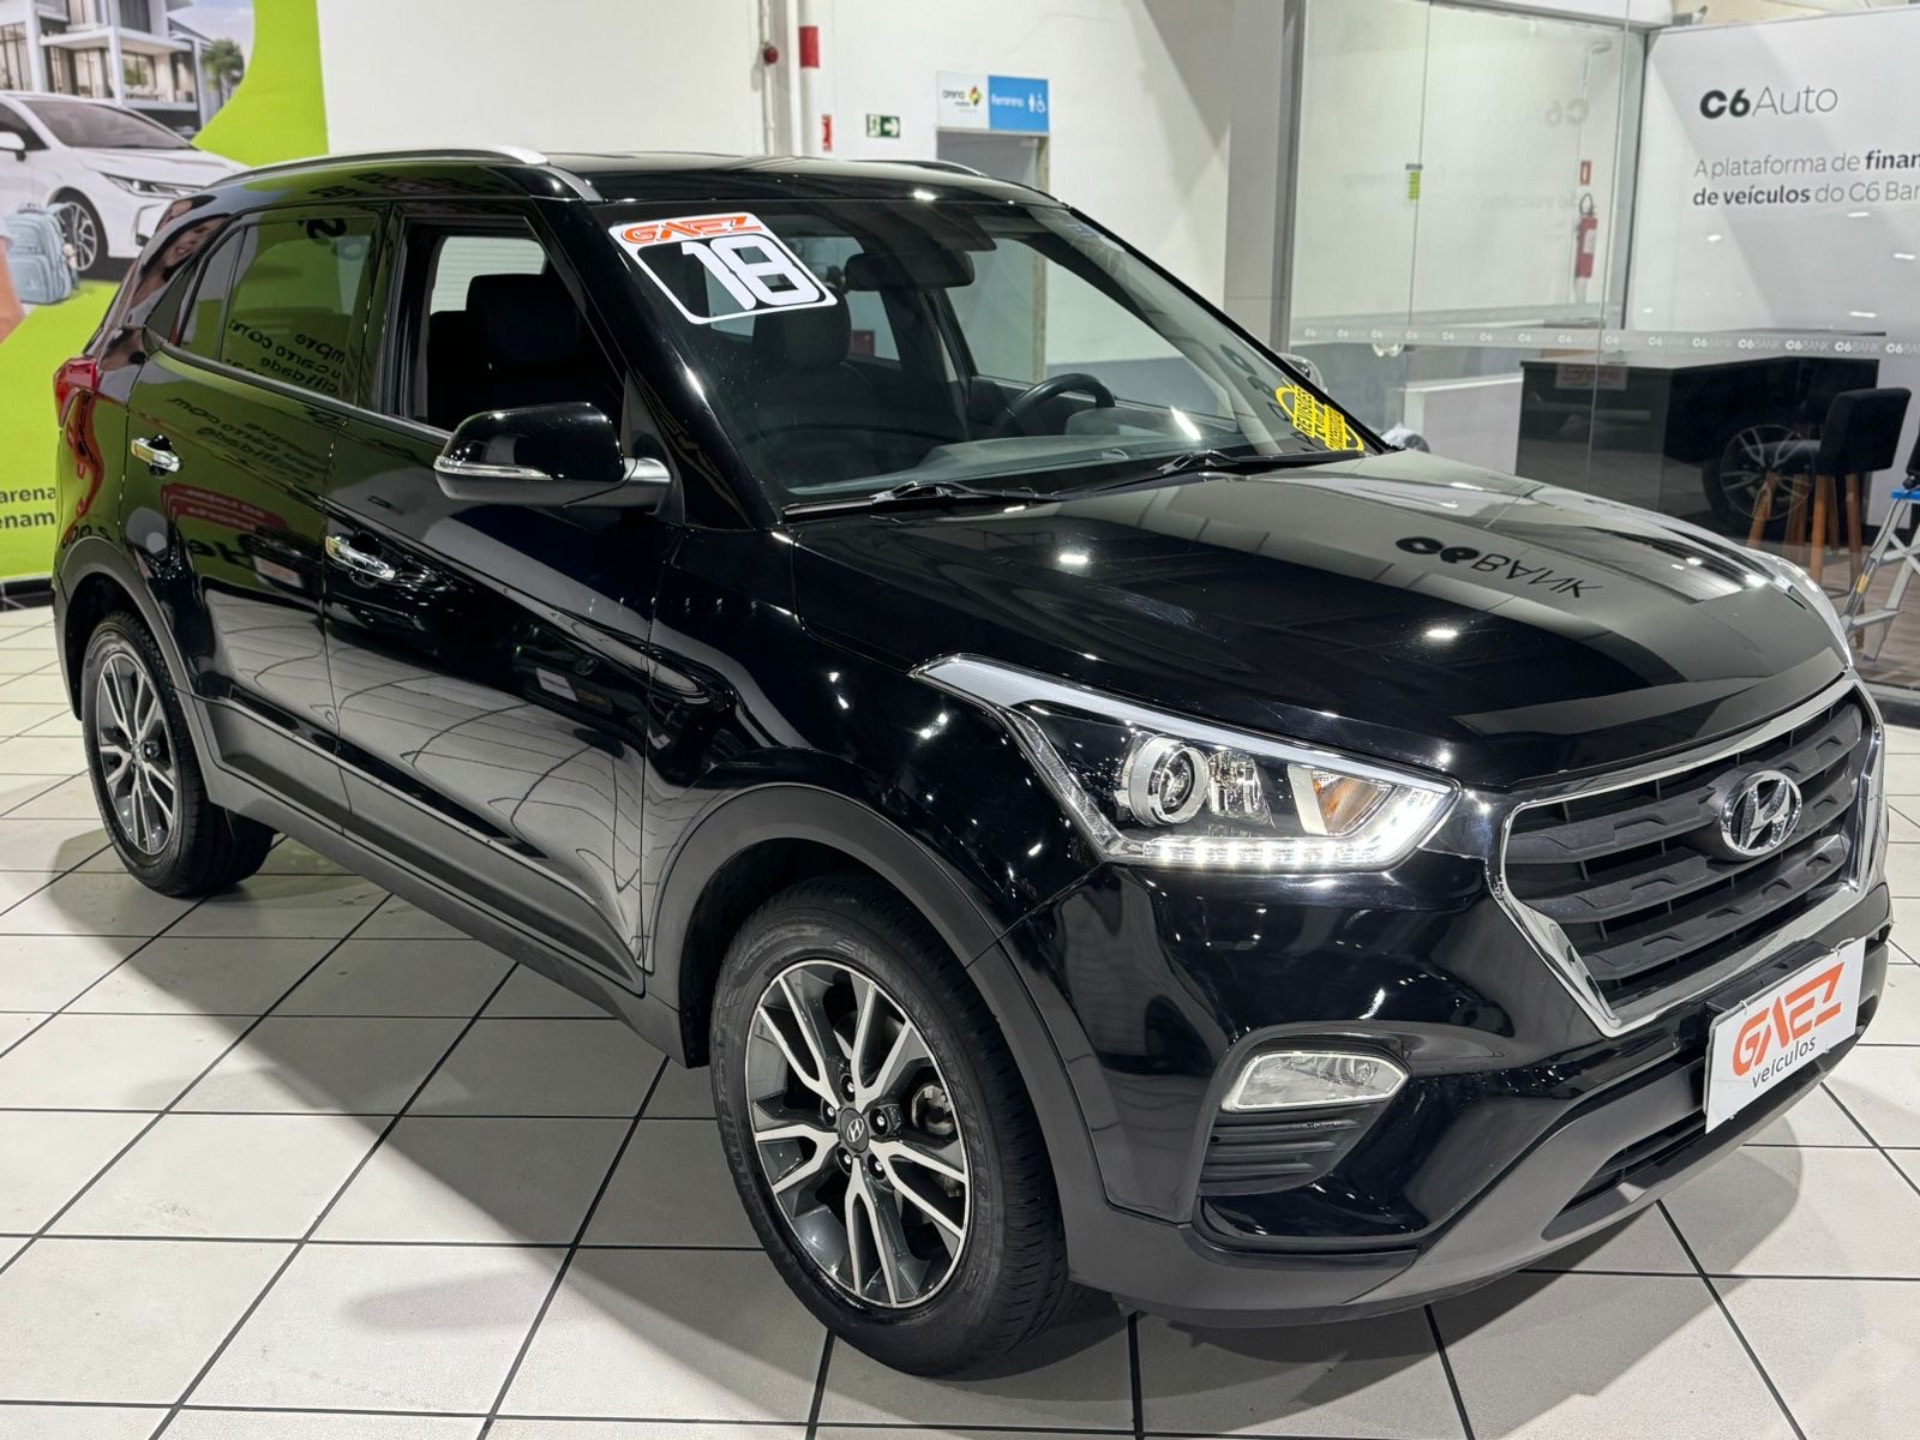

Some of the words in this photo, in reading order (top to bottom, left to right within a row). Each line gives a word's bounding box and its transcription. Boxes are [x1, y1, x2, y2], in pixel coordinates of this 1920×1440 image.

[1695, 159, 1708, 178] A
[1711, 155, 1827, 180] plataforma
[1831, 153, 1861, 173] de
[1692, 187, 1719, 206] de
[1723, 184, 1811, 205] veículos
[1815, 183, 1845, 203] do
[1849, 181, 1881, 202] C6
[681, 234, 820, 310] 18
[1732, 962, 1844, 1077] GAEZ
